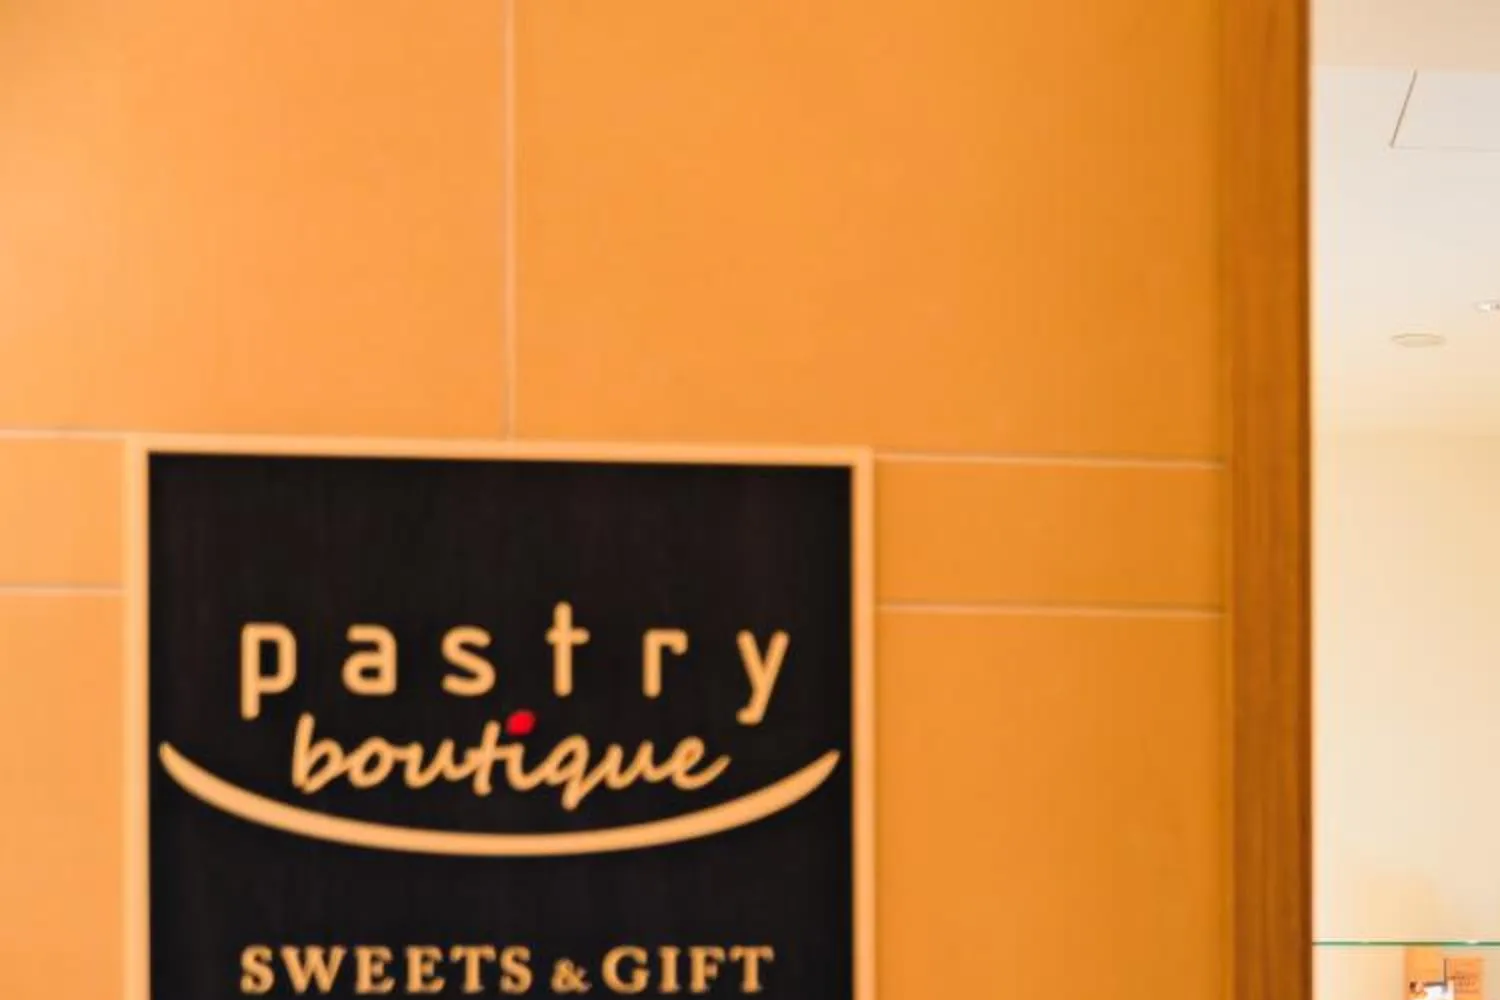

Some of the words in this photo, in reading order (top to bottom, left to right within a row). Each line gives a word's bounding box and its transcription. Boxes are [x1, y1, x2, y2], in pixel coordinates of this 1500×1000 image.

[239, 602, 790, 725] pastry
[291, 710, 731, 811] boutique
[239, 945, 533, 994] SWEETS
[551, 958, 591, 993] &
[602, 945, 775, 994] GIFT
